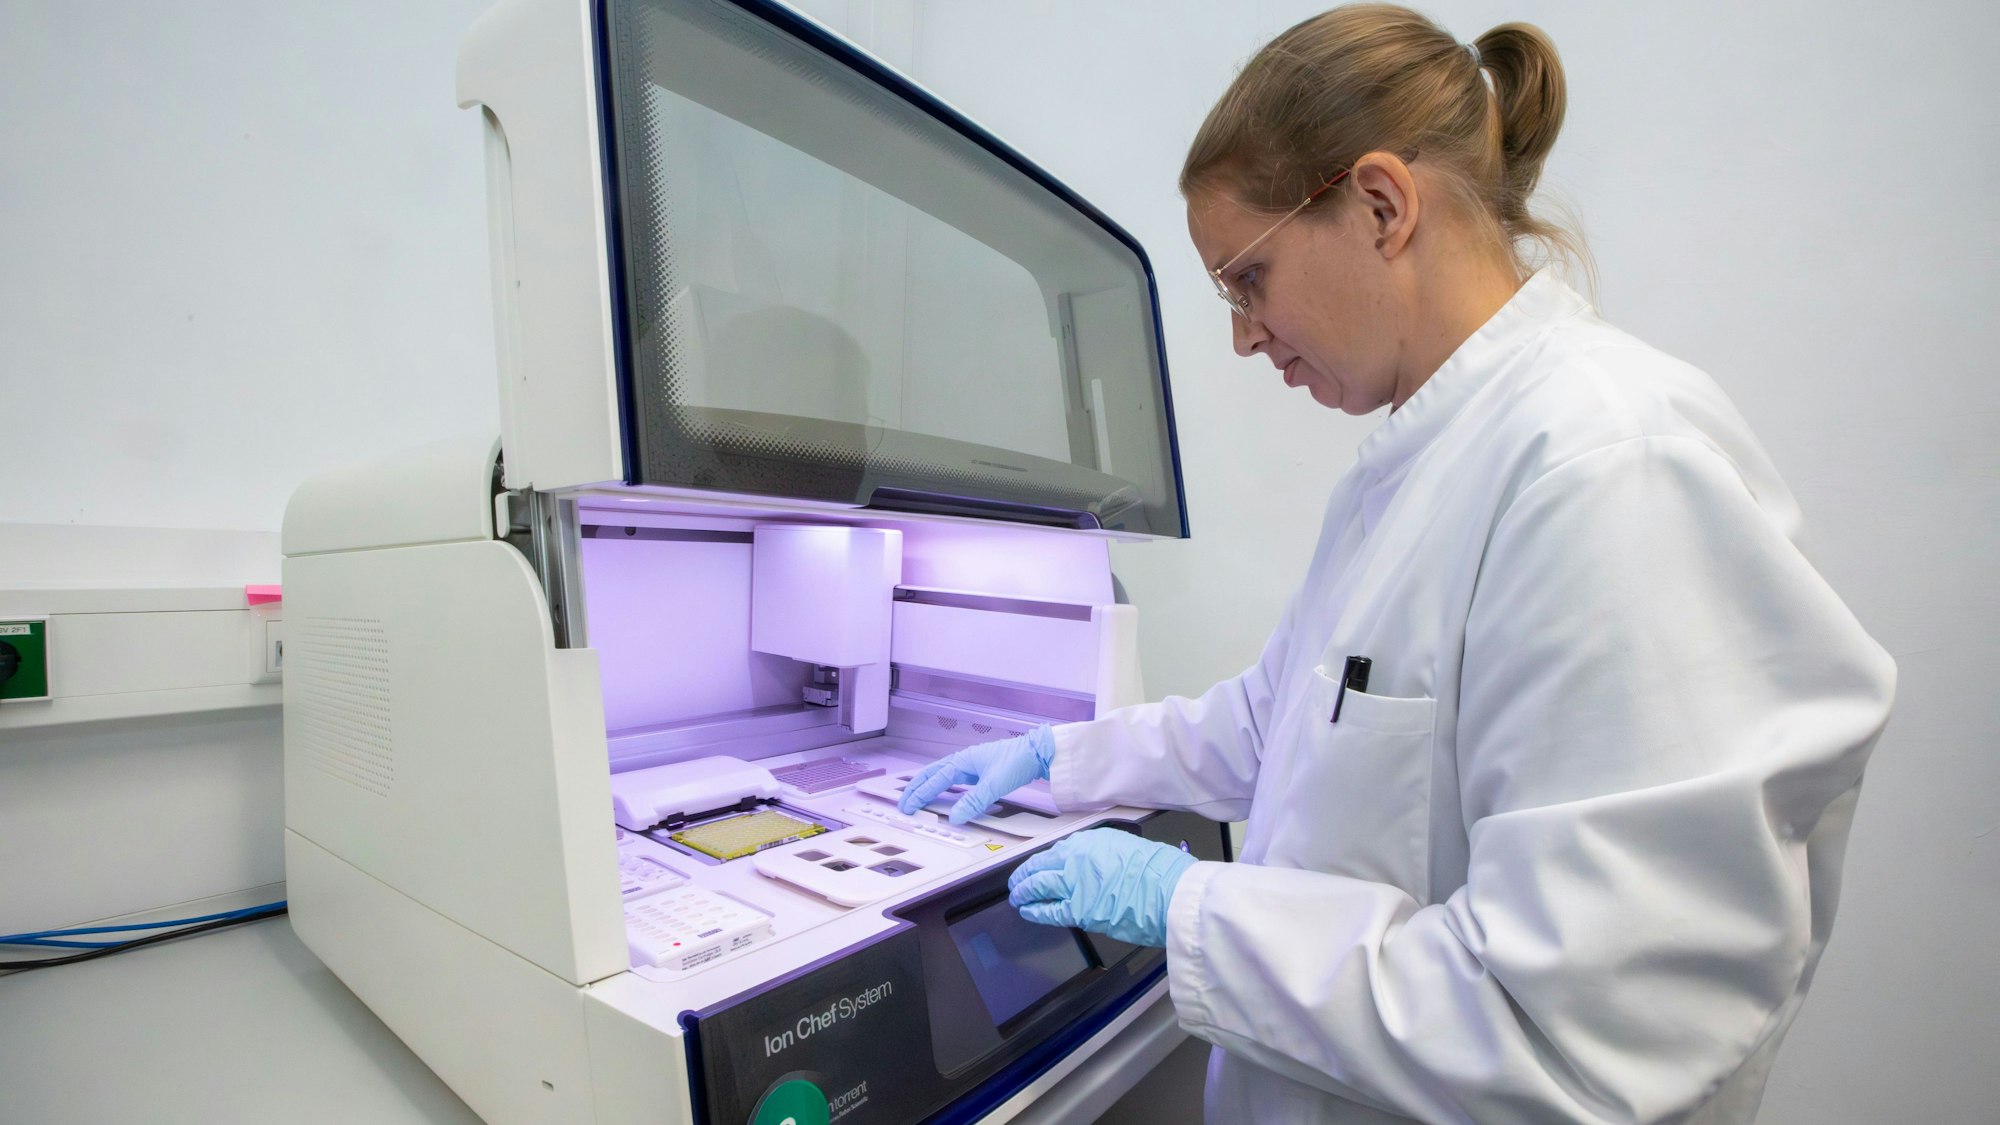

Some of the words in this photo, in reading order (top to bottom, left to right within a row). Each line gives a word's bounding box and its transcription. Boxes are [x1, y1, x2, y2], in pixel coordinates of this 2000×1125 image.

[764, 1030, 794, 1058] Ion
[796, 1003, 837, 1039] Chef
[839, 981, 893, 1019] System
